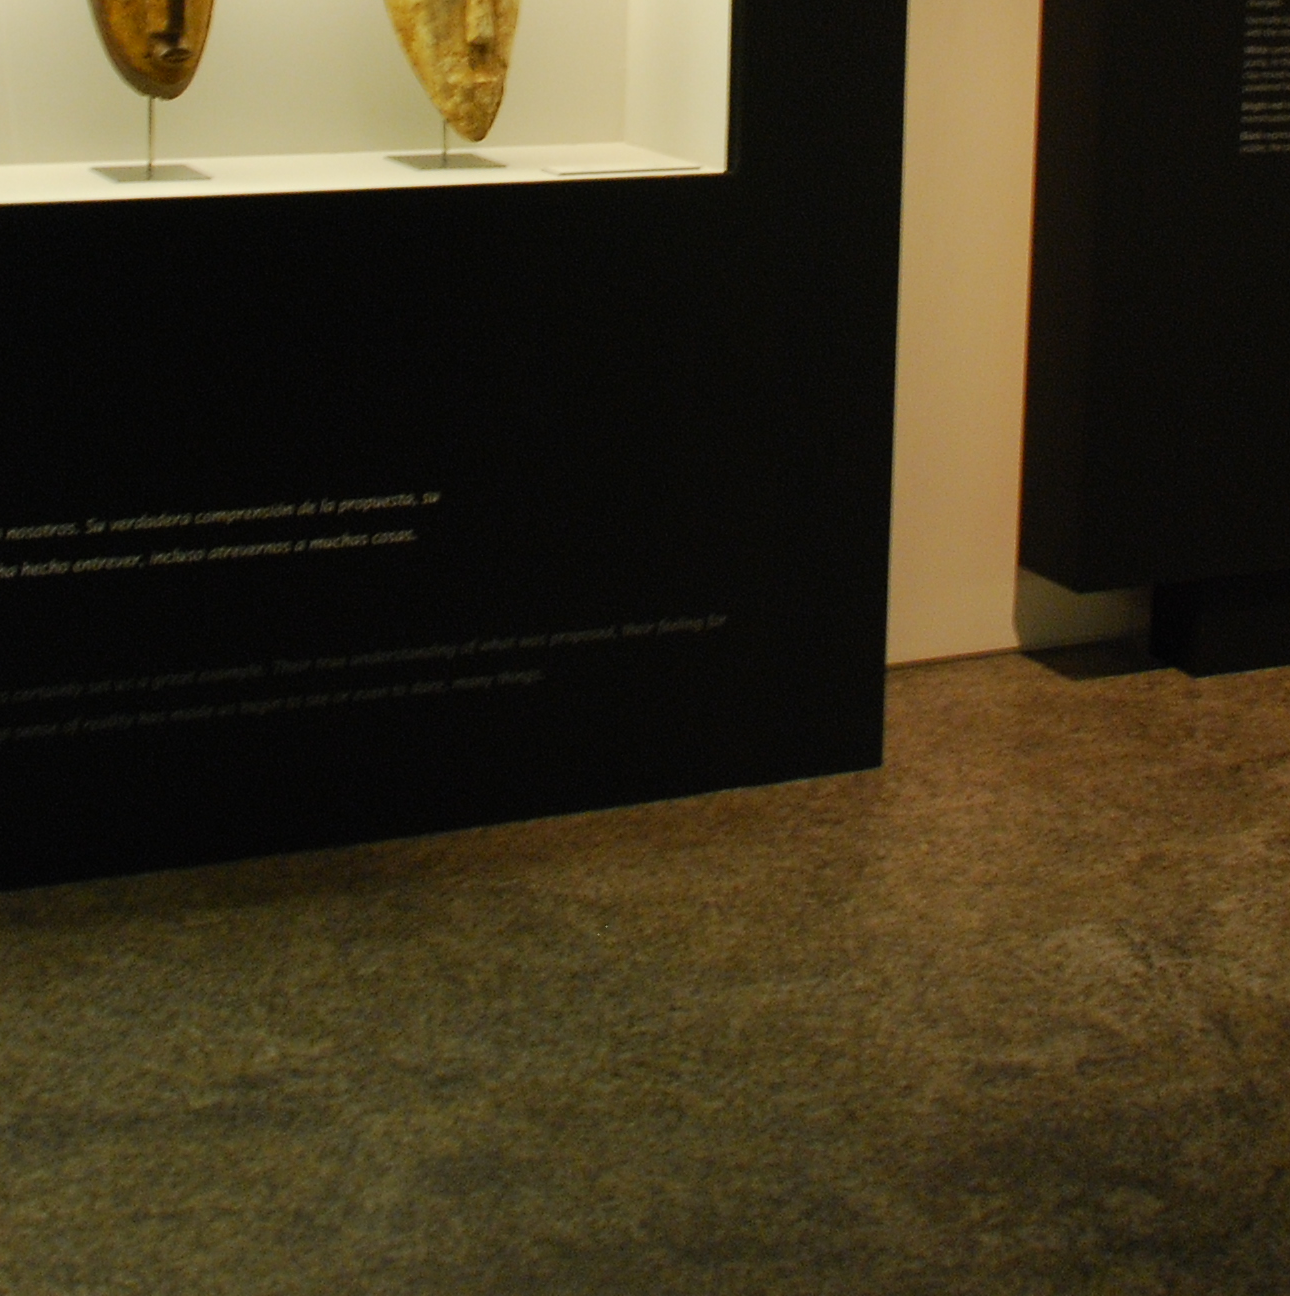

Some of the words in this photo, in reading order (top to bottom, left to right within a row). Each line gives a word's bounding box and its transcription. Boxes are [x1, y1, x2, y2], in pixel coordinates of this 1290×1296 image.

[5, 523, 80, 540] nosotros.
[85, 518, 106, 534] Su
[110, 513, 192, 531] verdadera
[297, 500, 317, 516] de
[319, 498, 336, 513] la
[422, 492, 440, 504] su
[20, 559, 70, 576] hecho
[149, 548, 205, 565] incluso
[207, 541, 291, 560] atrevernos
[294, 540, 306, 552] a
[309, 532, 369, 550] muchas
[371, 529, 417, 545] cosas.
